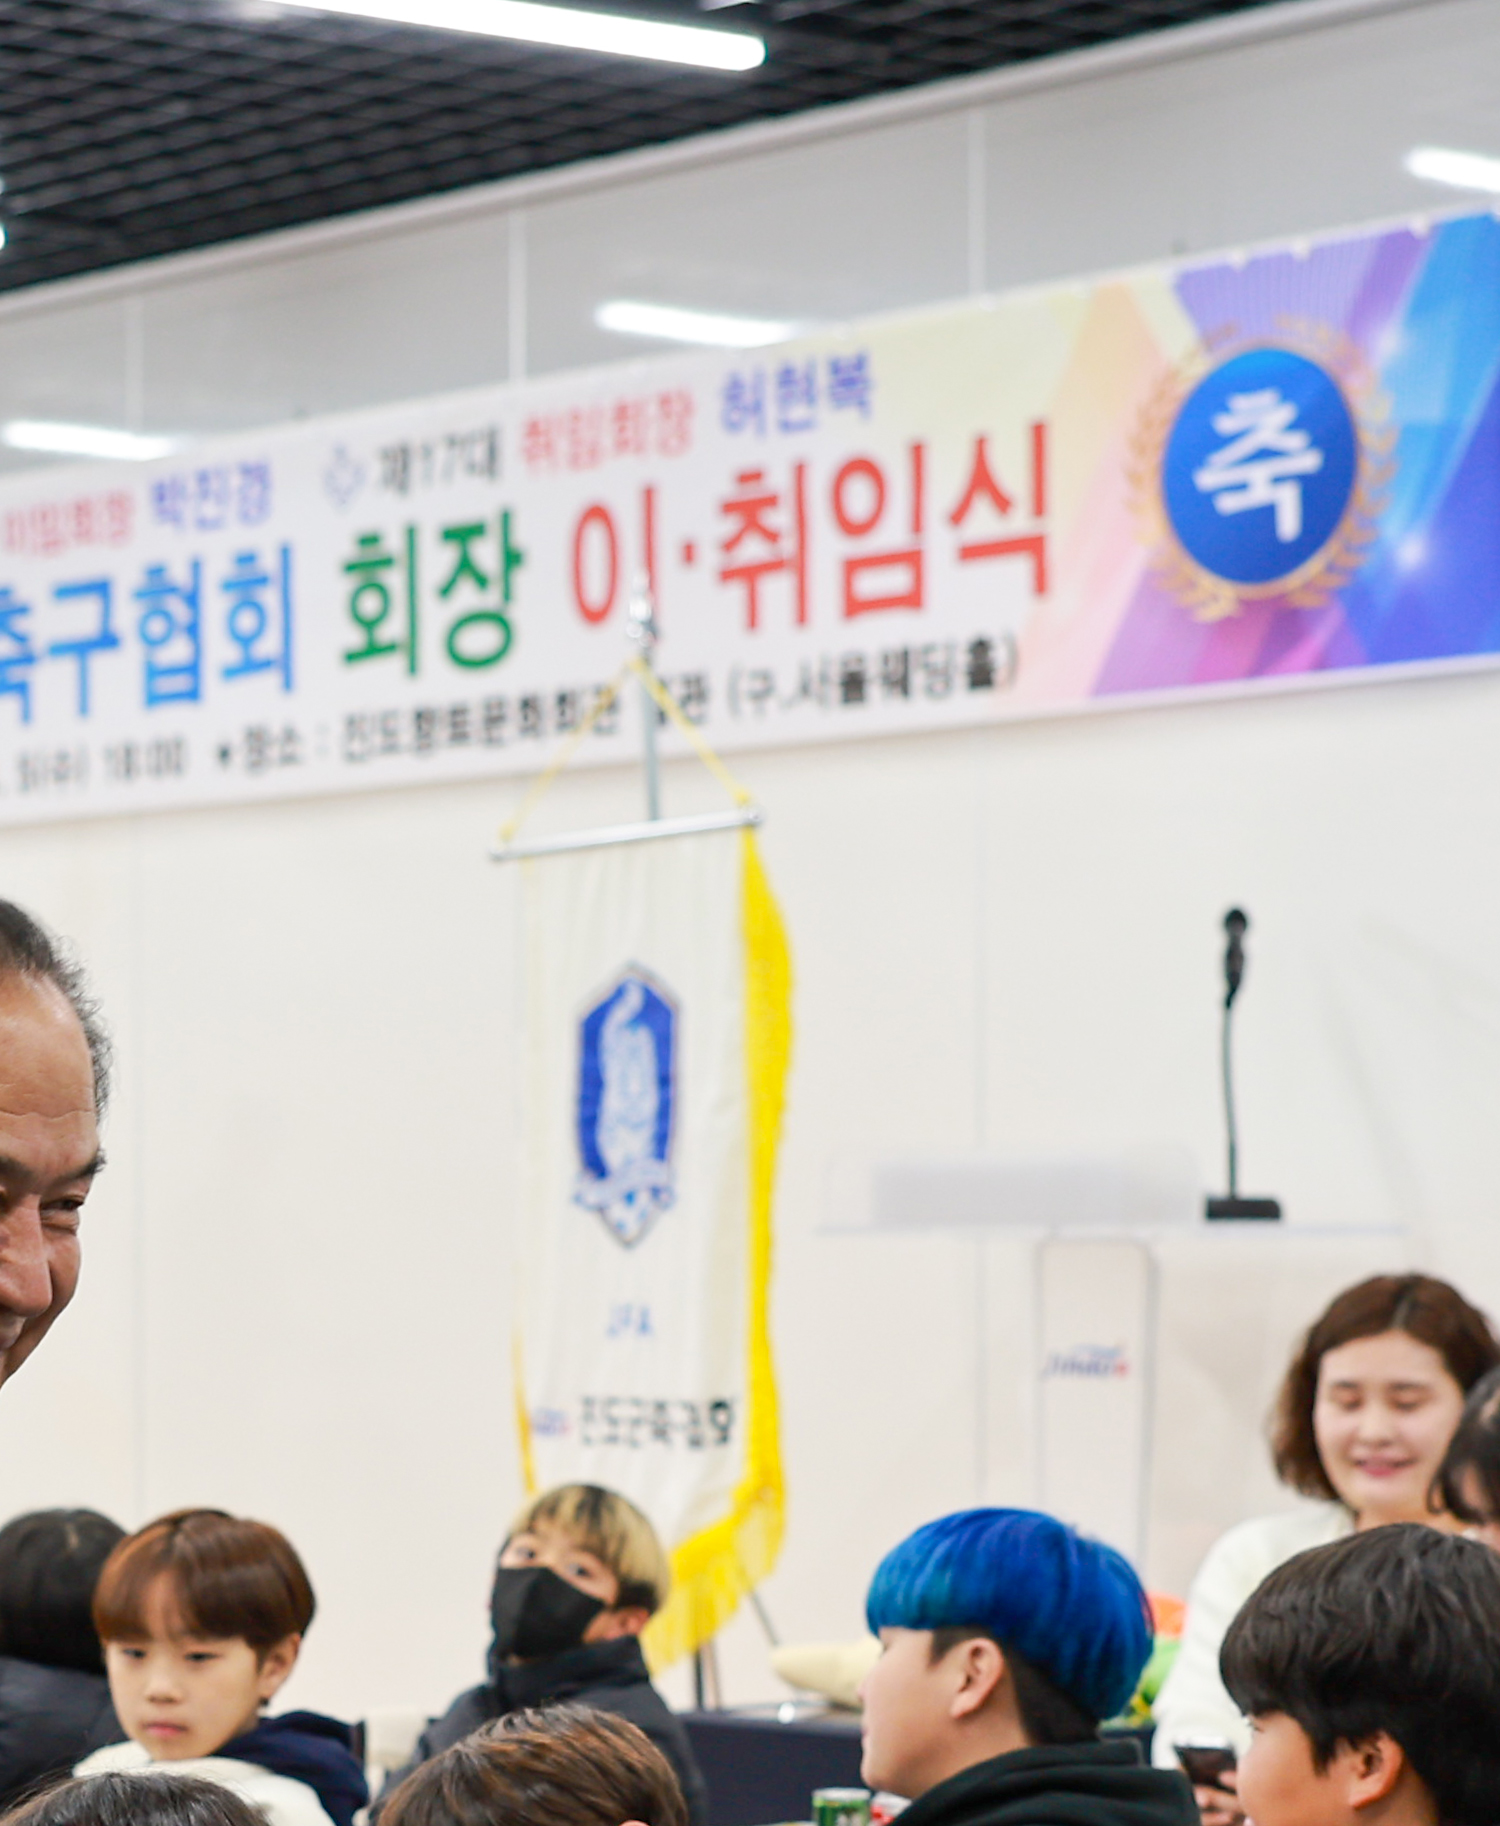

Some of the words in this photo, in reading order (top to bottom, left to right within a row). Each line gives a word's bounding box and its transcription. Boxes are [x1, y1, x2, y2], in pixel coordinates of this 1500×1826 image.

[377, 422, 503, 494] 제17대
[1190, 385, 1324, 543] 축
[340, 507, 525, 677] 회장
[573, 420, 1049, 640] 이·취임식
